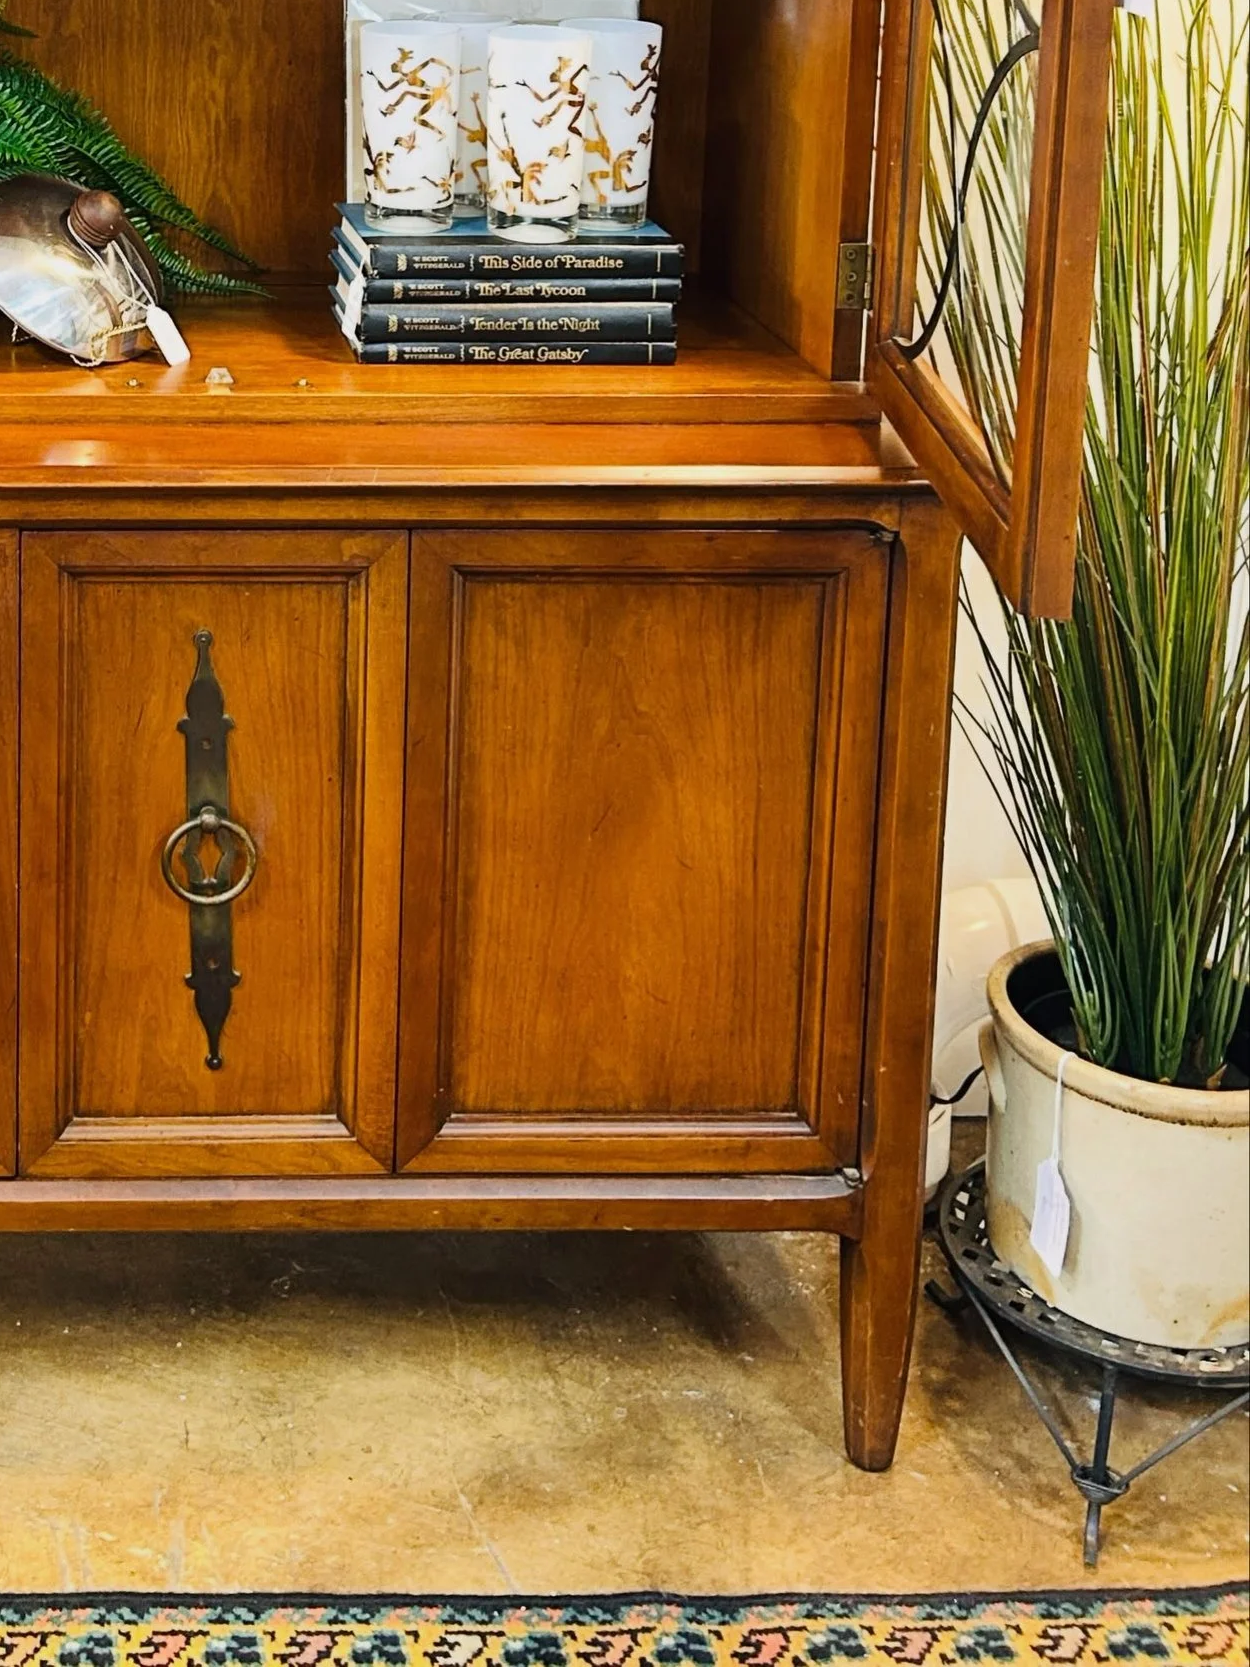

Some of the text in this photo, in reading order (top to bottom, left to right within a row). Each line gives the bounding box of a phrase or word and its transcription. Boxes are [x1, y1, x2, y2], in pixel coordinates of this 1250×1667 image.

[479, 255, 624, 271] This Side of Paradise
[474, 282, 586, 298] The Last Tycoon
[469, 317, 600, 332] Tender Is the Night
[468, 346, 589, 363] The Great Gatsby
